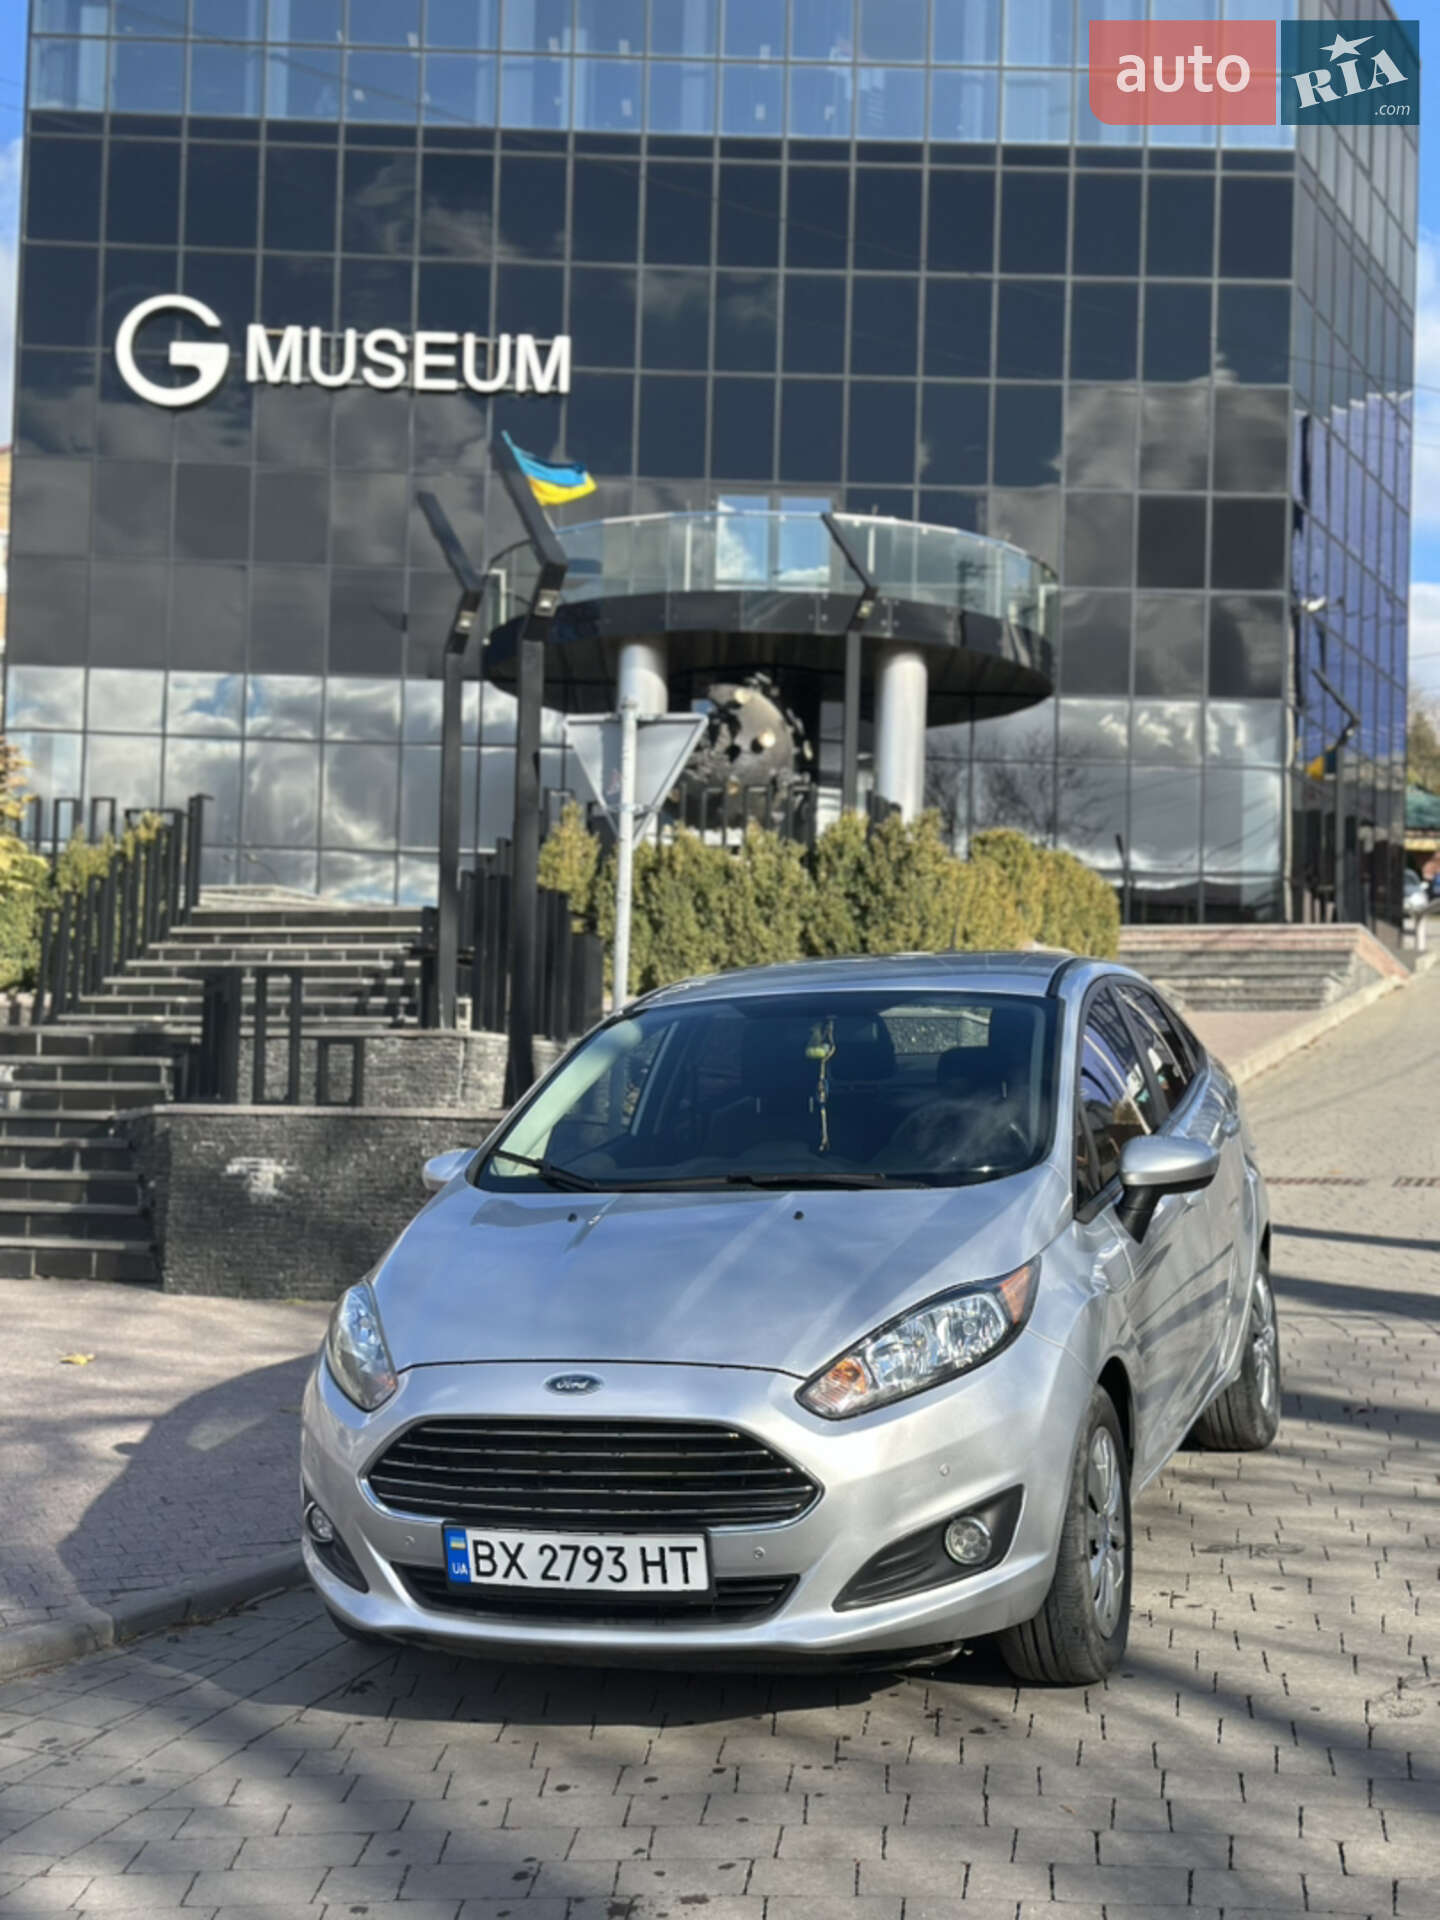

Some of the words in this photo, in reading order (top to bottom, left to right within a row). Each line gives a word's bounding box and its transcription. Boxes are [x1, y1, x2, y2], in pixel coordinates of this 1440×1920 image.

[115, 293, 230, 407] G
[246, 323, 571, 394] MUSEUM
[452, 1562, 468, 1576] UA
[473, 1540, 527, 1580] BX
[538, 1544, 628, 1584] 2793
[640, 1546, 698, 1585] HT
